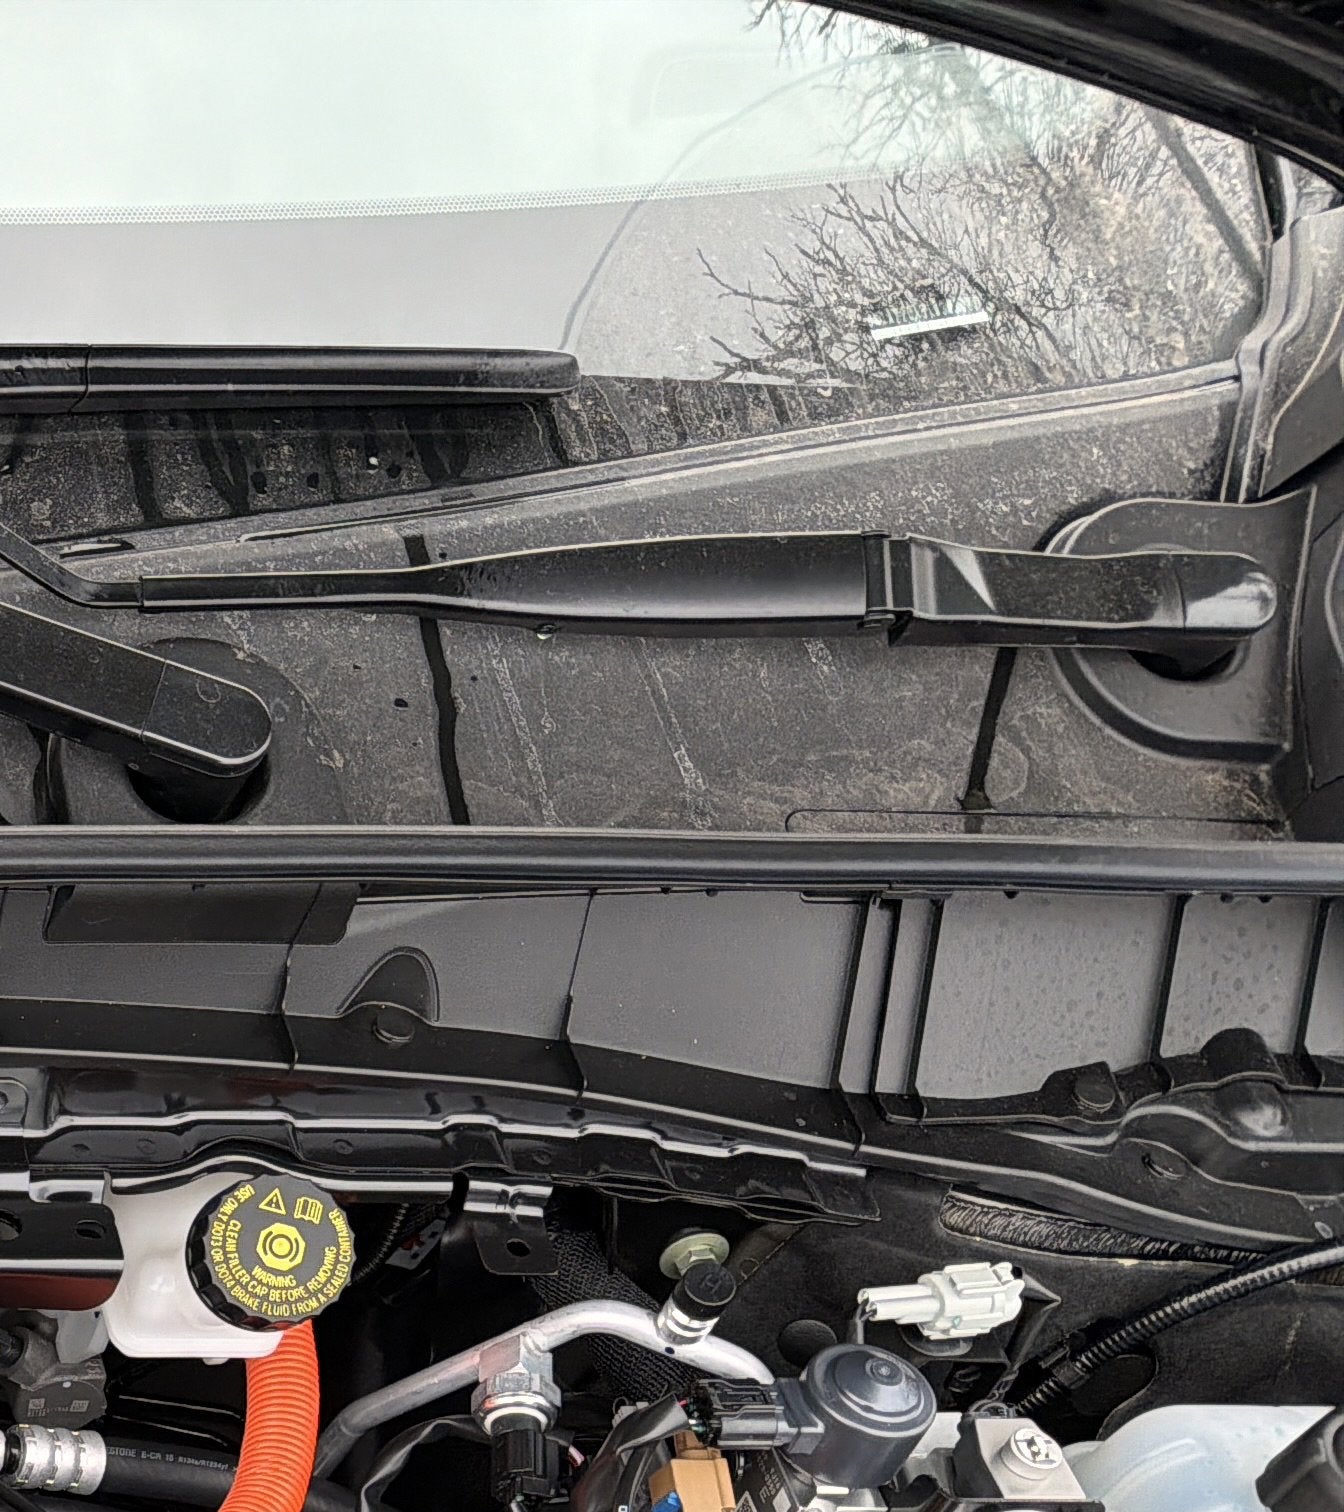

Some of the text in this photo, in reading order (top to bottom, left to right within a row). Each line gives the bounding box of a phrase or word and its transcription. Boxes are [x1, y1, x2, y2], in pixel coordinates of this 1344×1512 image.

[211, 1184, 352, 1316] USE ONLY DOT3 OR DOT4 BRAKE FLUID FROM A SEALED CONTAINER
[226, 1219, 337, 1301] CLEAN FILLER CAP BEFORE REMOVING
[252, 1265, 296, 1287] WARNING
